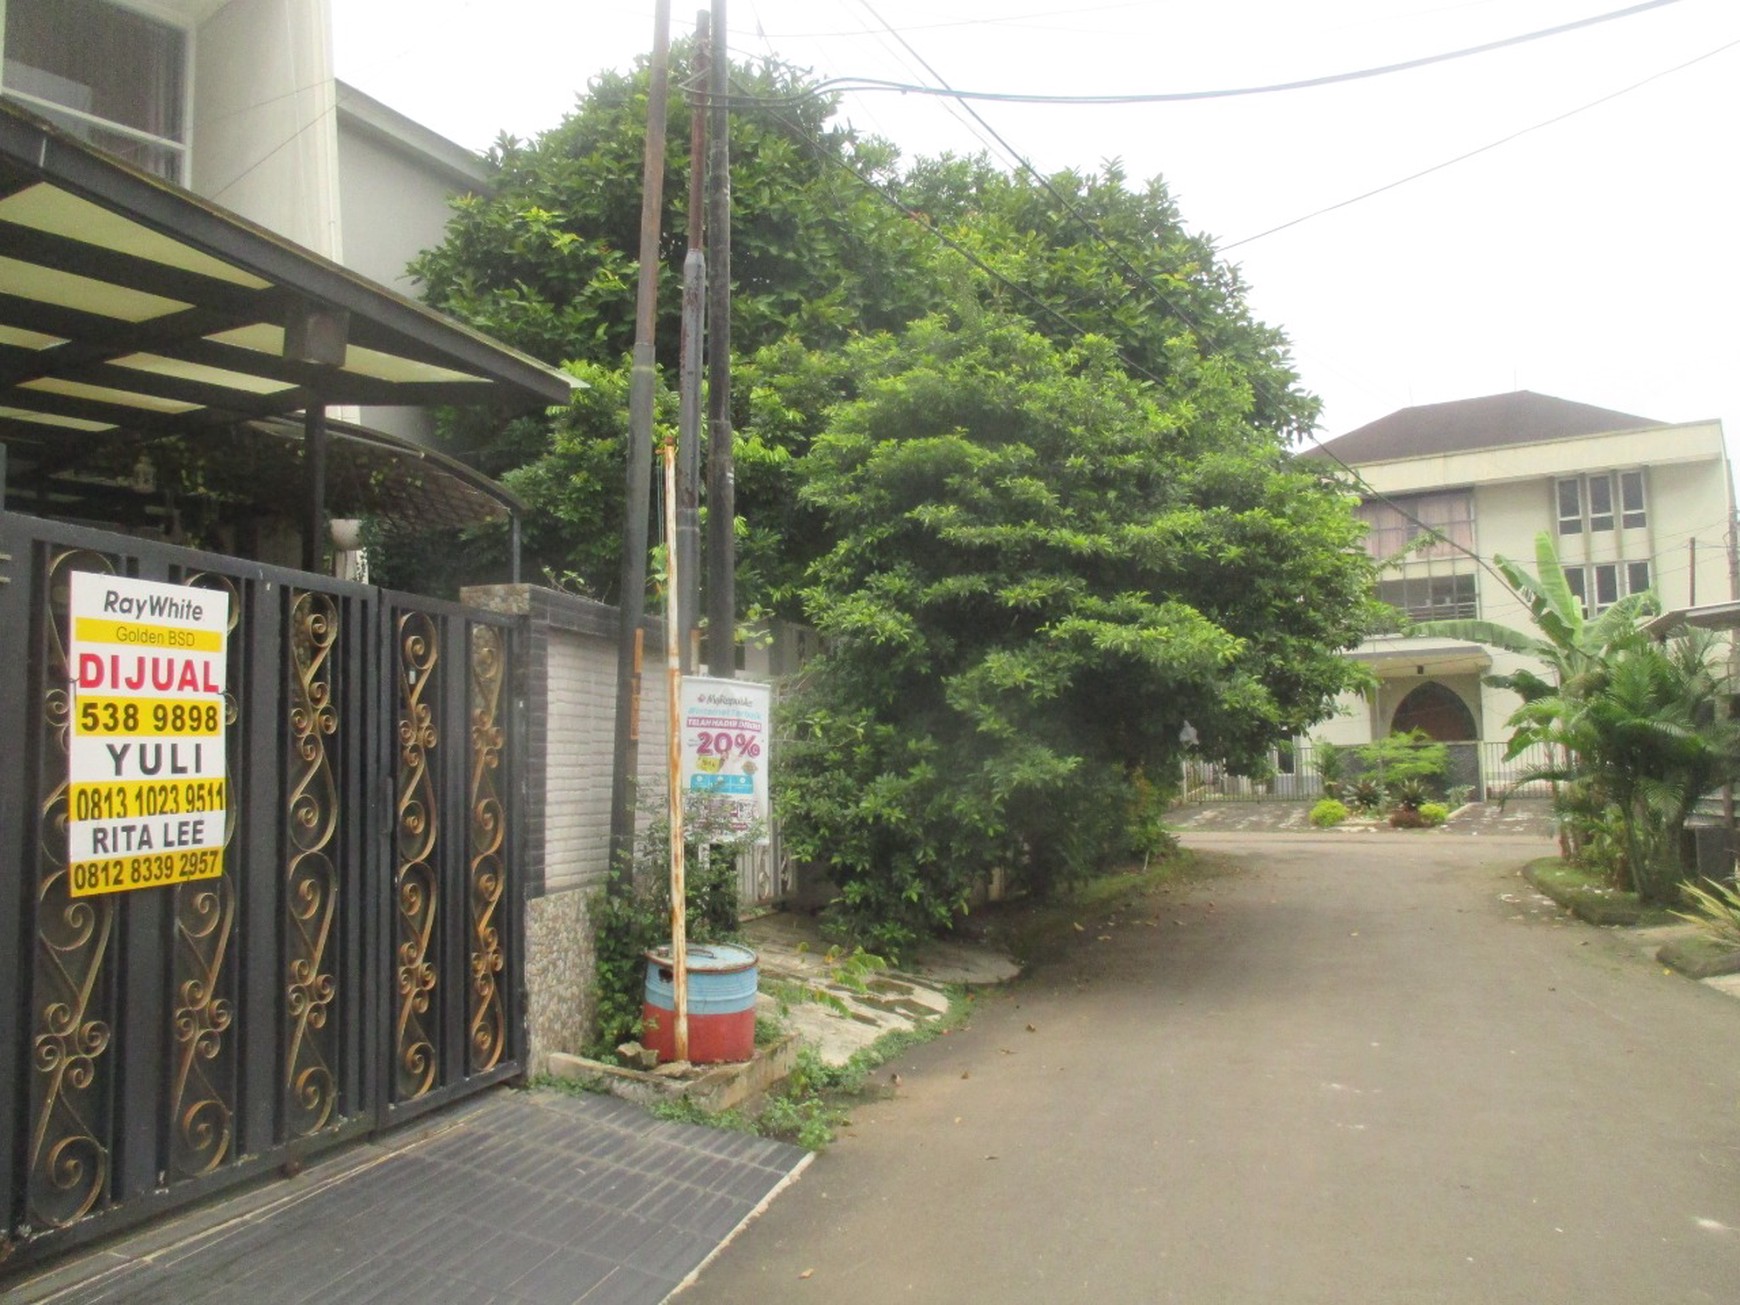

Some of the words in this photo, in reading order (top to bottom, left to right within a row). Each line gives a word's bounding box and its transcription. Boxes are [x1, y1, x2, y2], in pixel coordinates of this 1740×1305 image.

[116, 626, 164, 645] Golden
[168, 630, 195, 647] BSD
[79, 653, 219, 693] DIJUAL
[81, 702, 139, 732] 538
[153, 704, 218, 732] 9898
[106, 743, 202, 776] YULI
[696, 731, 761, 758] 20%
[77, 785, 127, 821] 0813
[135, 783, 179, 817] 1023
[186, 781, 224, 814] 9511
[92, 823, 153, 854] RITA
[164, 820, 205, 848] LEE
[74, 860, 124, 890] 0812
[130, 855, 174, 884] 8339
[179, 850, 219, 877] 2957
